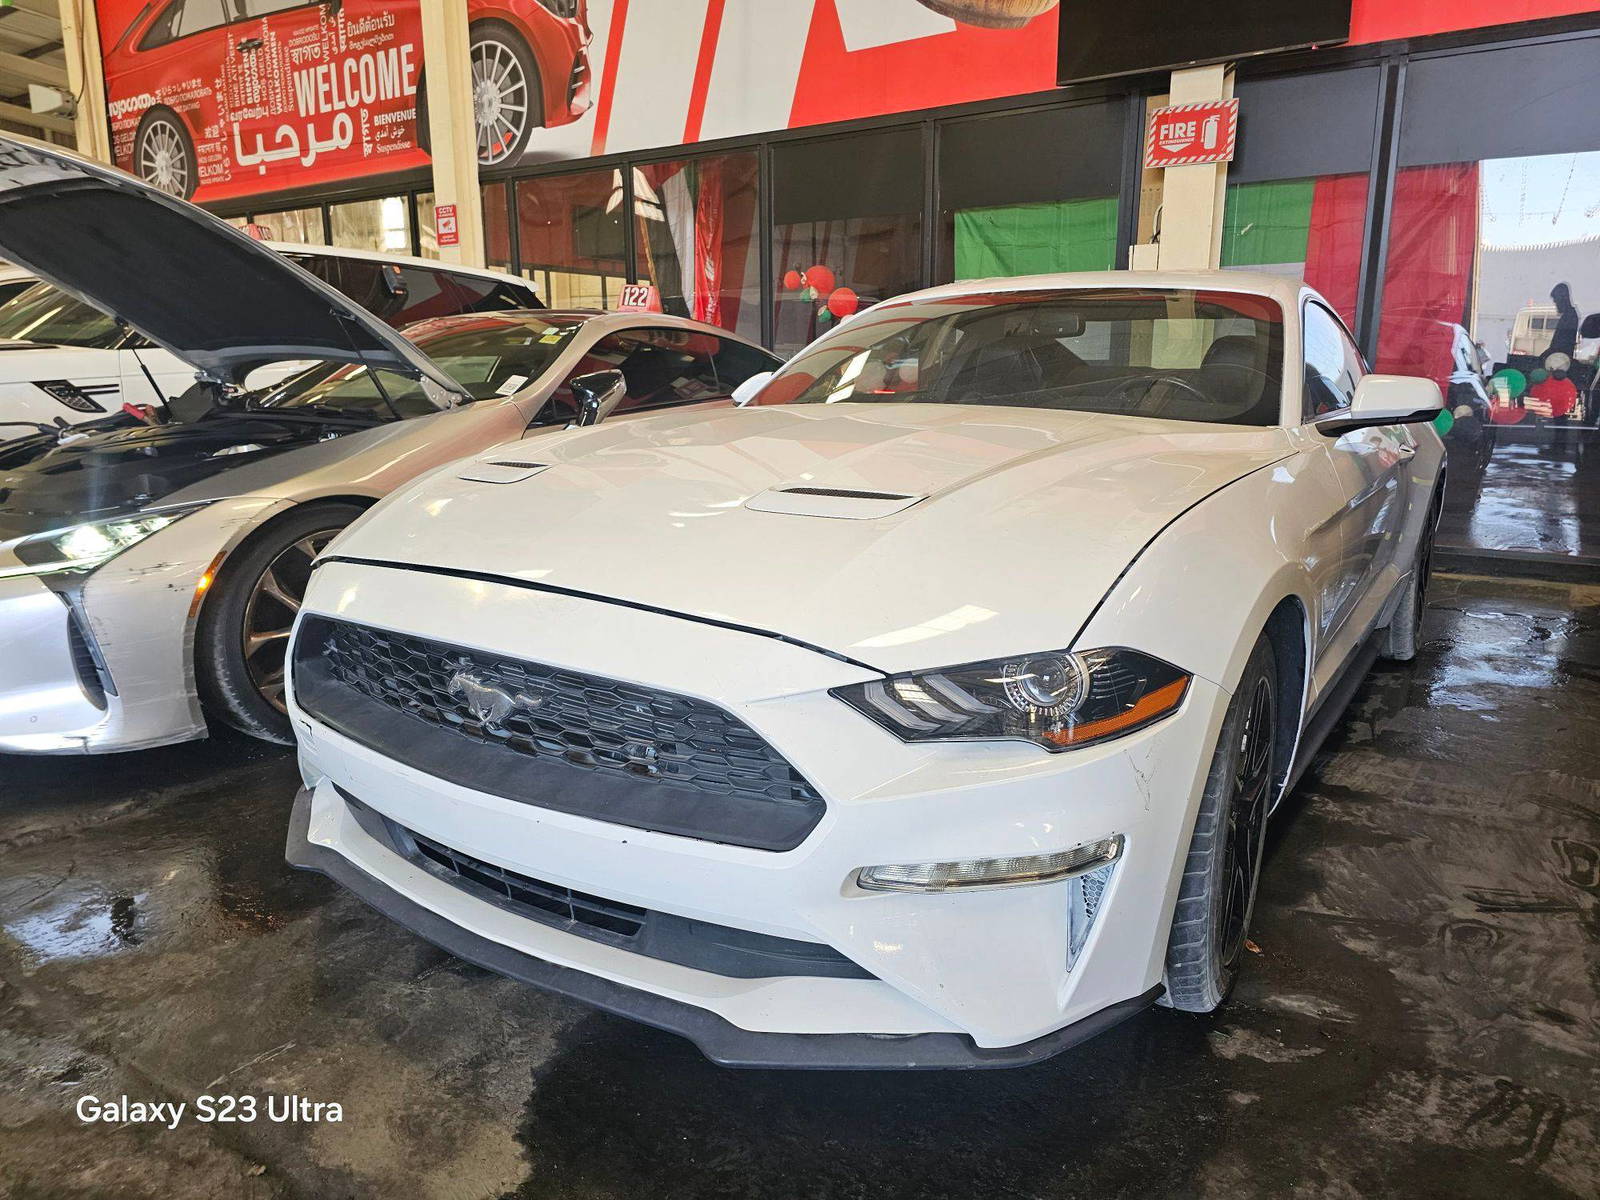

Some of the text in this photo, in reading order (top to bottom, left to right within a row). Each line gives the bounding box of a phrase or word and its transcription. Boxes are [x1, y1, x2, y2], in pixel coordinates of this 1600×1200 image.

[270, 31, 283, 115] WILLKOMMEN
[294, 43, 417, 118] WELCOME
[374, 108, 417, 127] BIENVENUE
[1159, 120, 1197, 140] FIRE
[232, 113, 353, 175] مرحبا
[199, 164, 224, 179] ELKOM
[623, 286, 649, 307] 122
